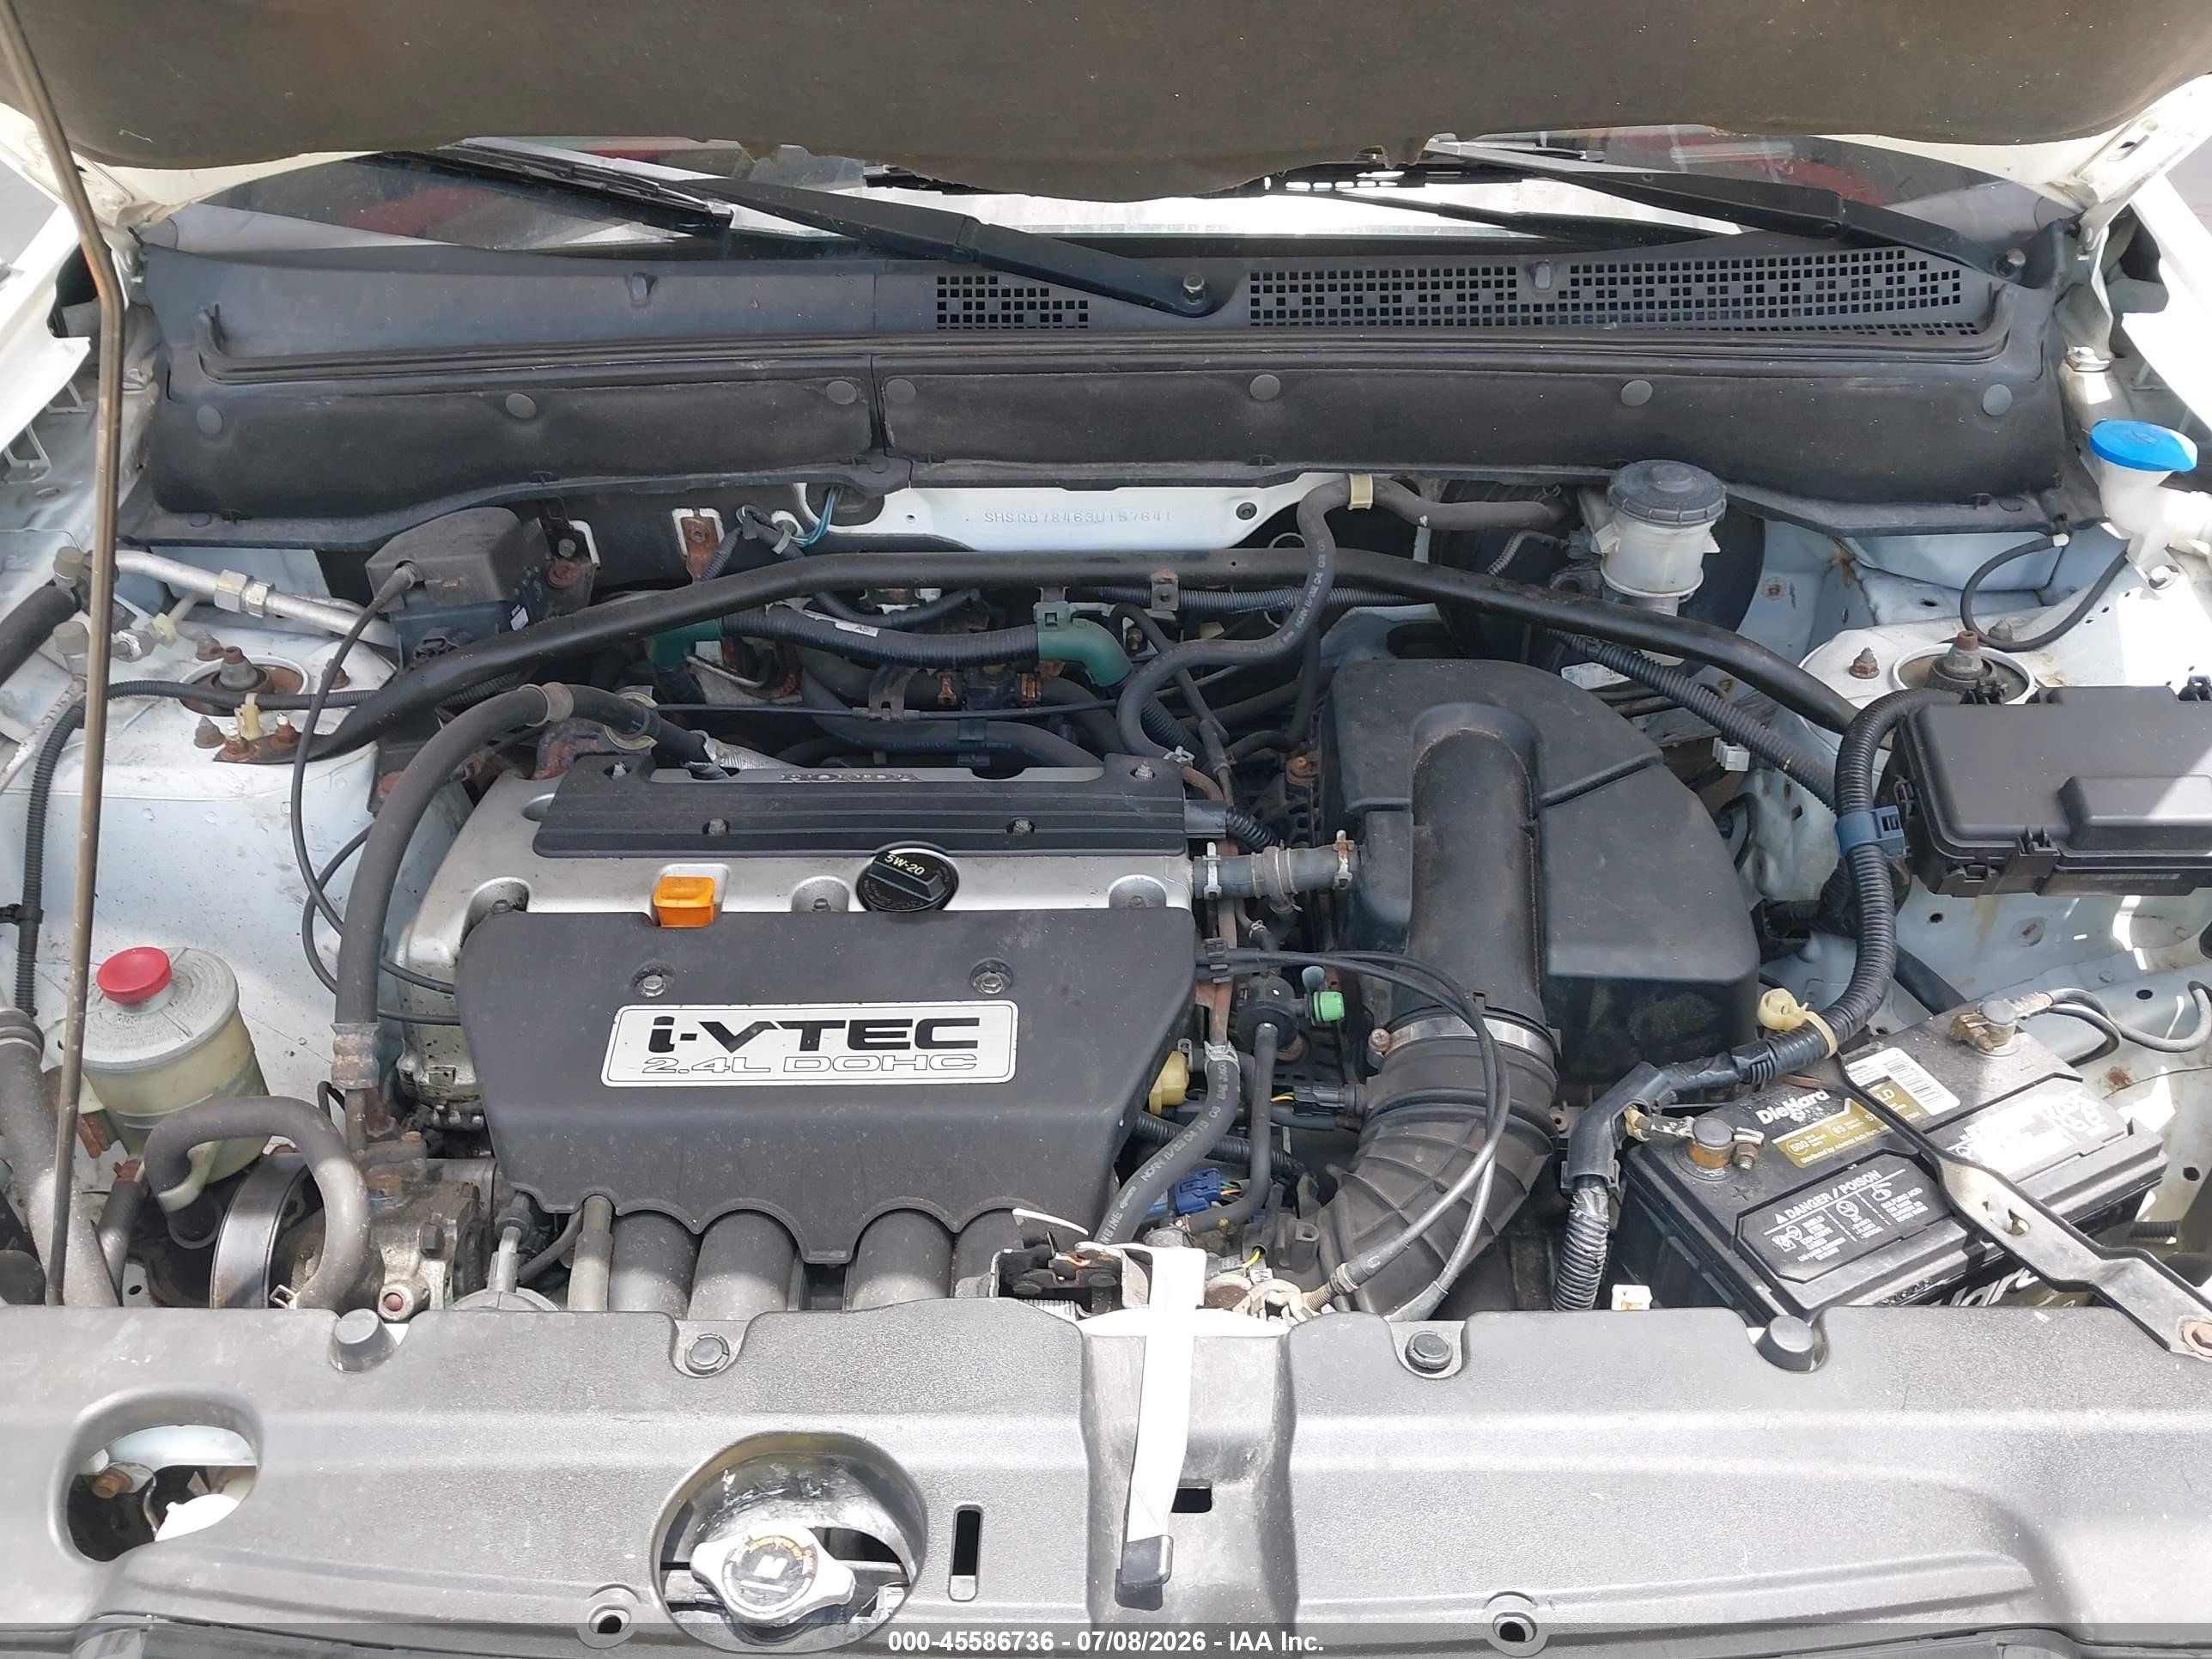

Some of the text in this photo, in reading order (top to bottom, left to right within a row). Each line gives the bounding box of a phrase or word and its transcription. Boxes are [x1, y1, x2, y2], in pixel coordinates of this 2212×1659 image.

[884, 854, 926, 876] 5W-20
[648, 1015, 981, 1054] i-VTEC
[641, 1054, 978, 1074] 2.4L DOHC
[1755, 1088, 1831, 1125] DieHard
[1789, 1139, 1810, 1152] 500
[1098, 1212, 1123, 1245] NGINE
